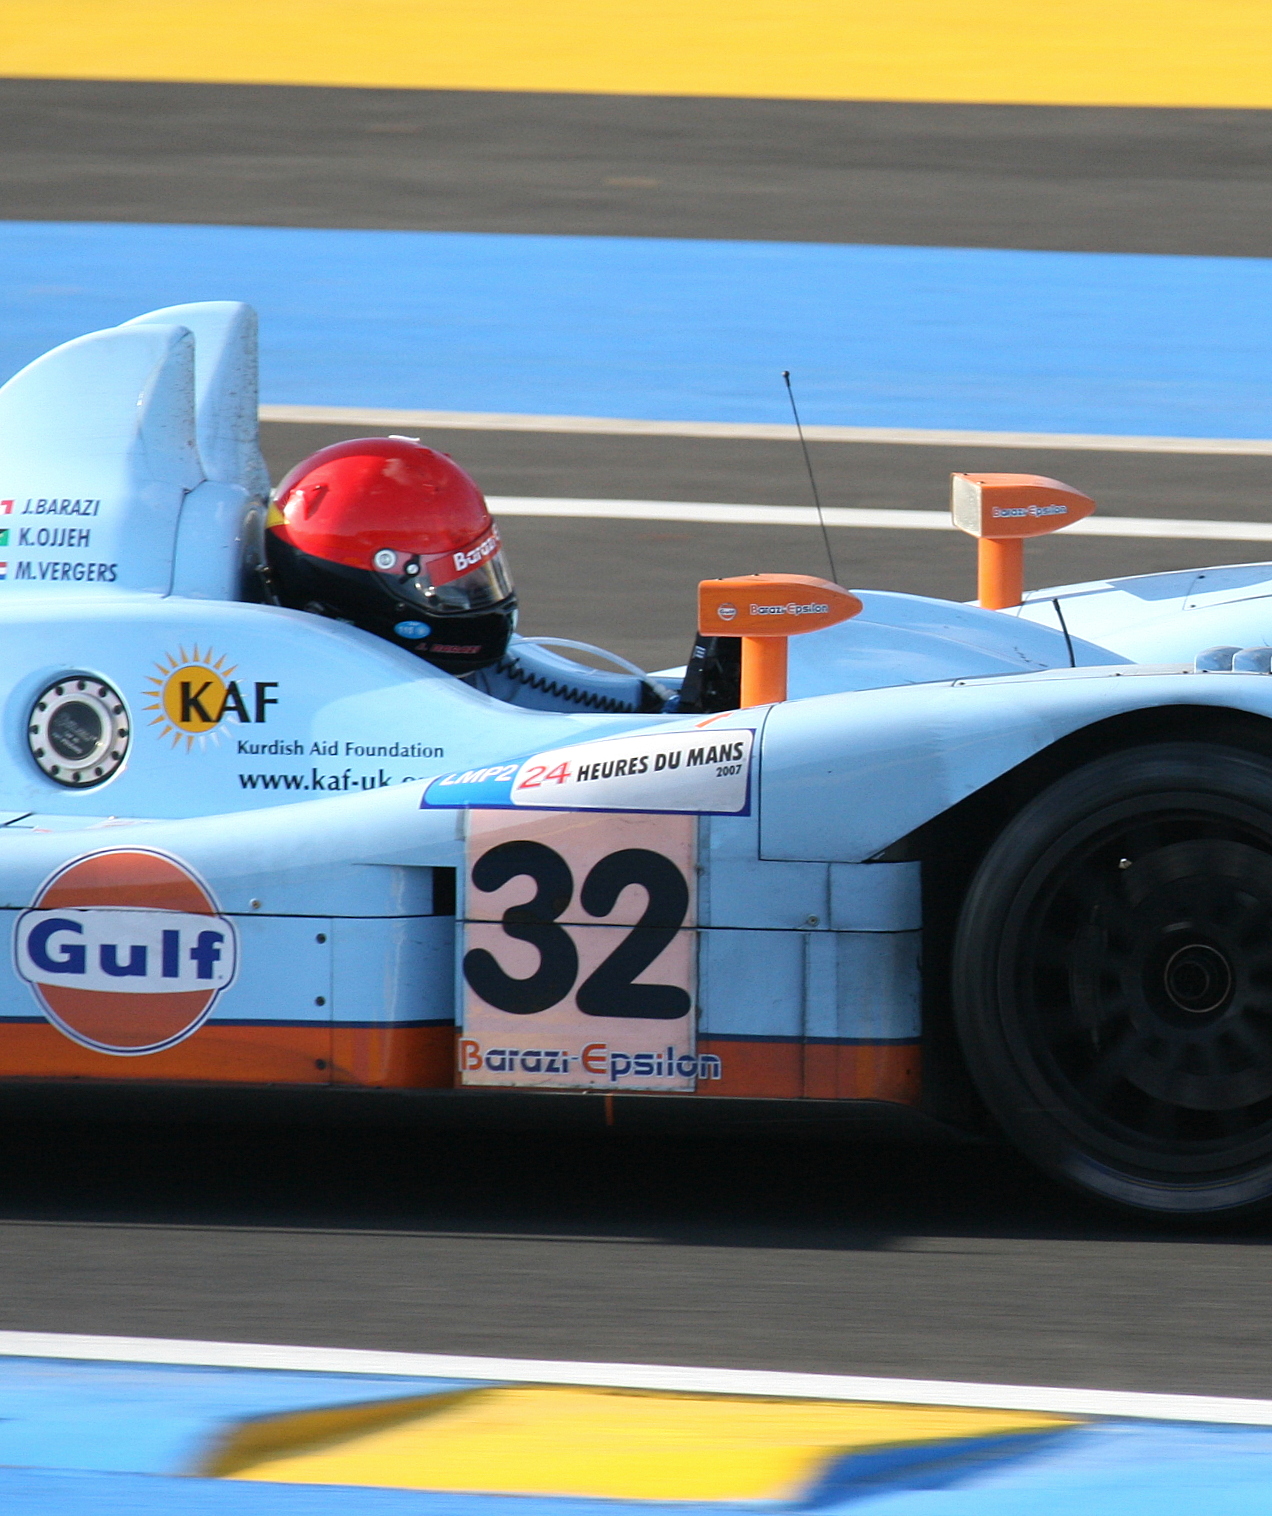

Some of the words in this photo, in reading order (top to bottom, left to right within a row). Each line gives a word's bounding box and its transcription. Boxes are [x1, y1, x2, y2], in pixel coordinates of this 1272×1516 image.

[21, 498, 101, 516] J.BARAZI
[18, 527, 91, 548] K.OJJEH
[15, 561, 118, 582] M.VERGERS
[179, 680, 280, 724] KAF
[237, 740, 304, 756] Kurdish
[309, 741, 339, 756] Aid
[345, 742, 444, 758] Foundation
[438, 764, 519, 786] LMP2
[516, 760, 572, 790] 24
[577, 755, 649, 782] HEURES
[654, 750, 682, 772] DU
[686, 742, 744, 767] MANS
[716, 764, 743, 778] 2007
[463, 840, 691, 1020] 32
[27, 917, 225, 980] Gulf
[459, 1037, 722, 1082] Barazi-Epsilon
